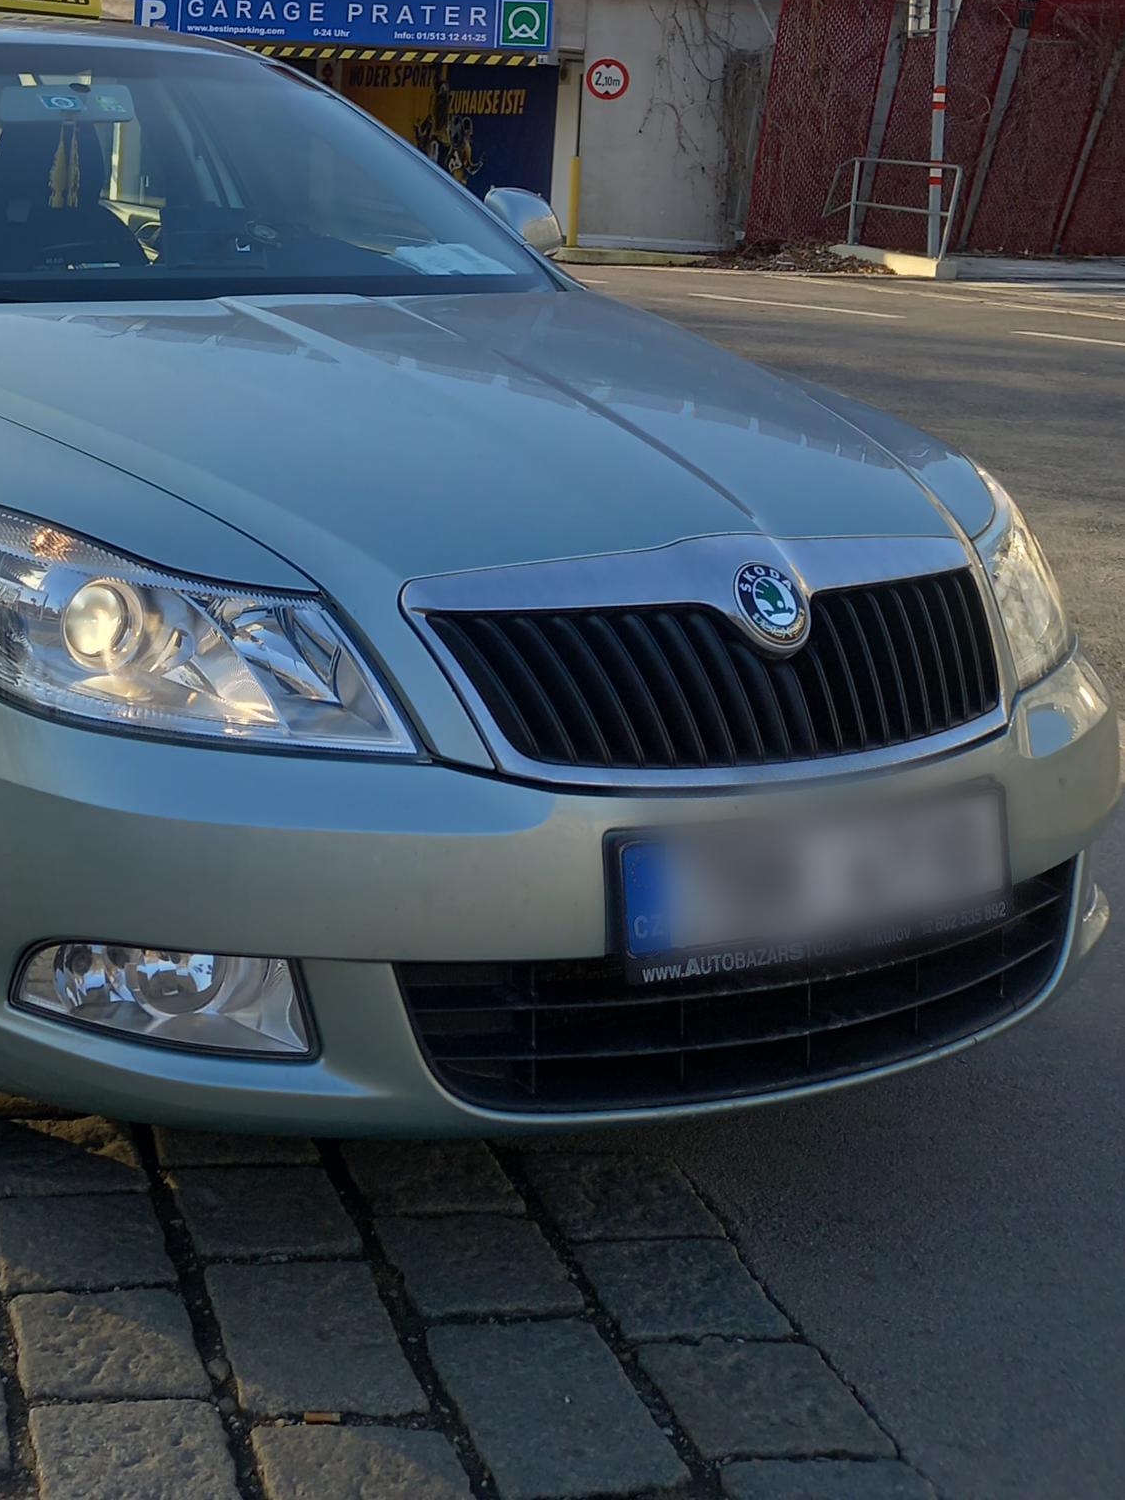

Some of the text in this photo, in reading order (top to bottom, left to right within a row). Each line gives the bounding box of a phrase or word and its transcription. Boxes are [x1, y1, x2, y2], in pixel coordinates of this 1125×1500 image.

[347, 3, 488, 27] PRATER
[186, 25, 487, 42] www.bestinparking.com 0-24 Uhr Info: 01/513 12 41-25
[363, 64, 391, 87] DER
[392, 64, 434, 88] SPORT
[448, 89, 526, 115] ZUHAUSE IST!
[739, 565, 793, 593] ŠKODA
[935, 916, 958, 933] 602
[984, 901, 1007, 922] 892
